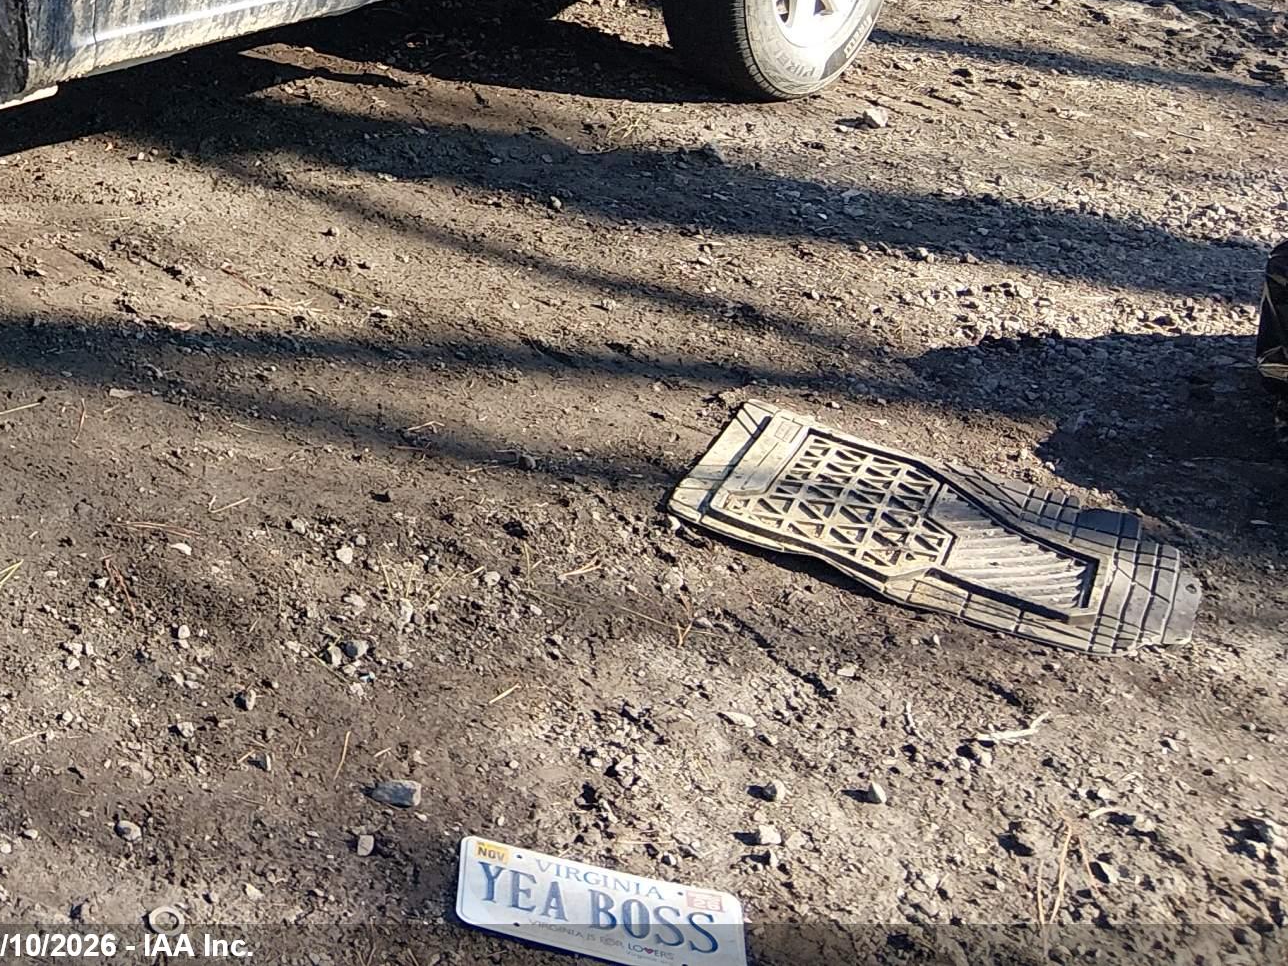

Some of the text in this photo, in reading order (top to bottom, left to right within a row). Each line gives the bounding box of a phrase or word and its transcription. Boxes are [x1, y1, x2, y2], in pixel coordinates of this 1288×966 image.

[478, 846, 505, 861] NOV
[535, 859, 665, 901] VIRGINIA
[479, 861, 718, 954] YEA BOSS
